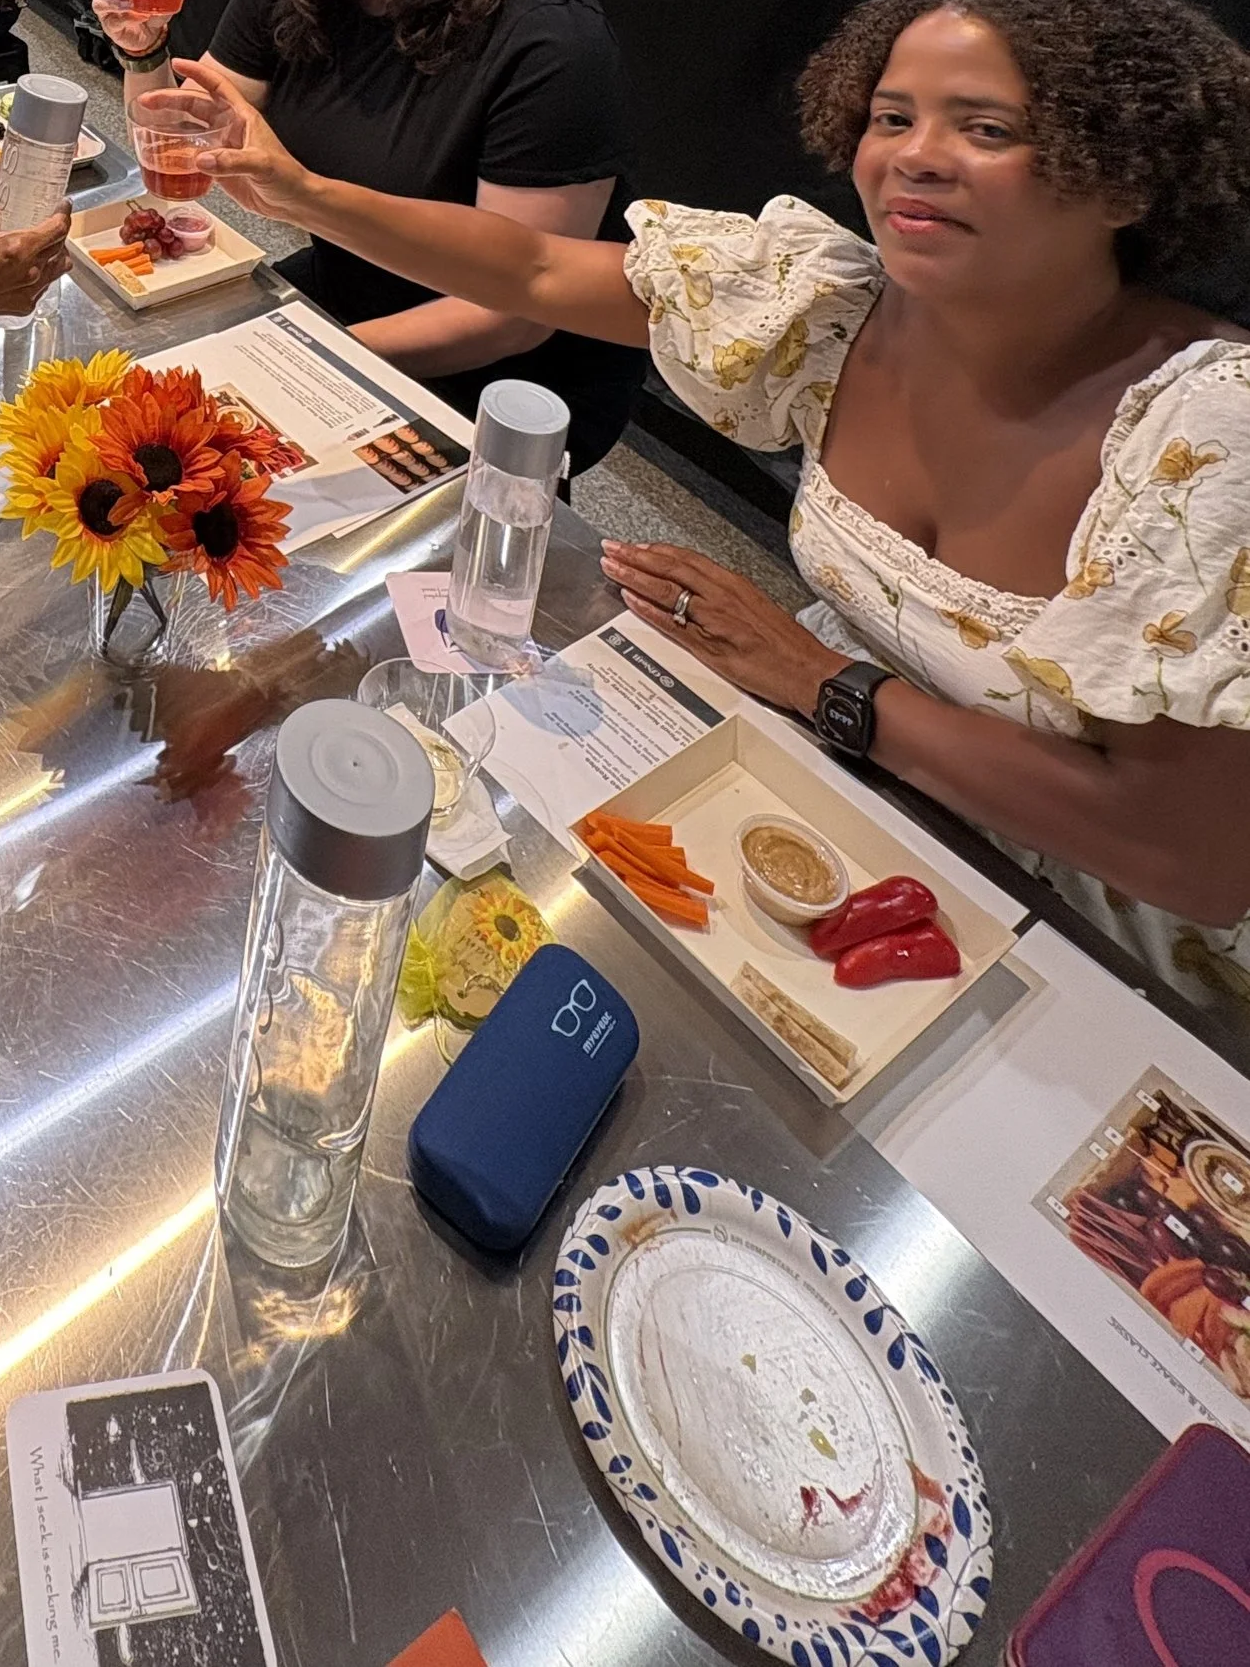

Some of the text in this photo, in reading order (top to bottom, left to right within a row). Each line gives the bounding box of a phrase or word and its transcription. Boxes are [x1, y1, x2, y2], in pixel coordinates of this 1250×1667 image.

[586, 662, 610, 683] County
[1106, 1315, 1149, 1359] CLASSIC
[29, 1446, 46, 1492] What
[38, 1505, 52, 1544] seek
[42, 1547, 49, 1560] is
[43, 1565, 60, 1632] seeking
[51, 1634, 61, 1665] me
